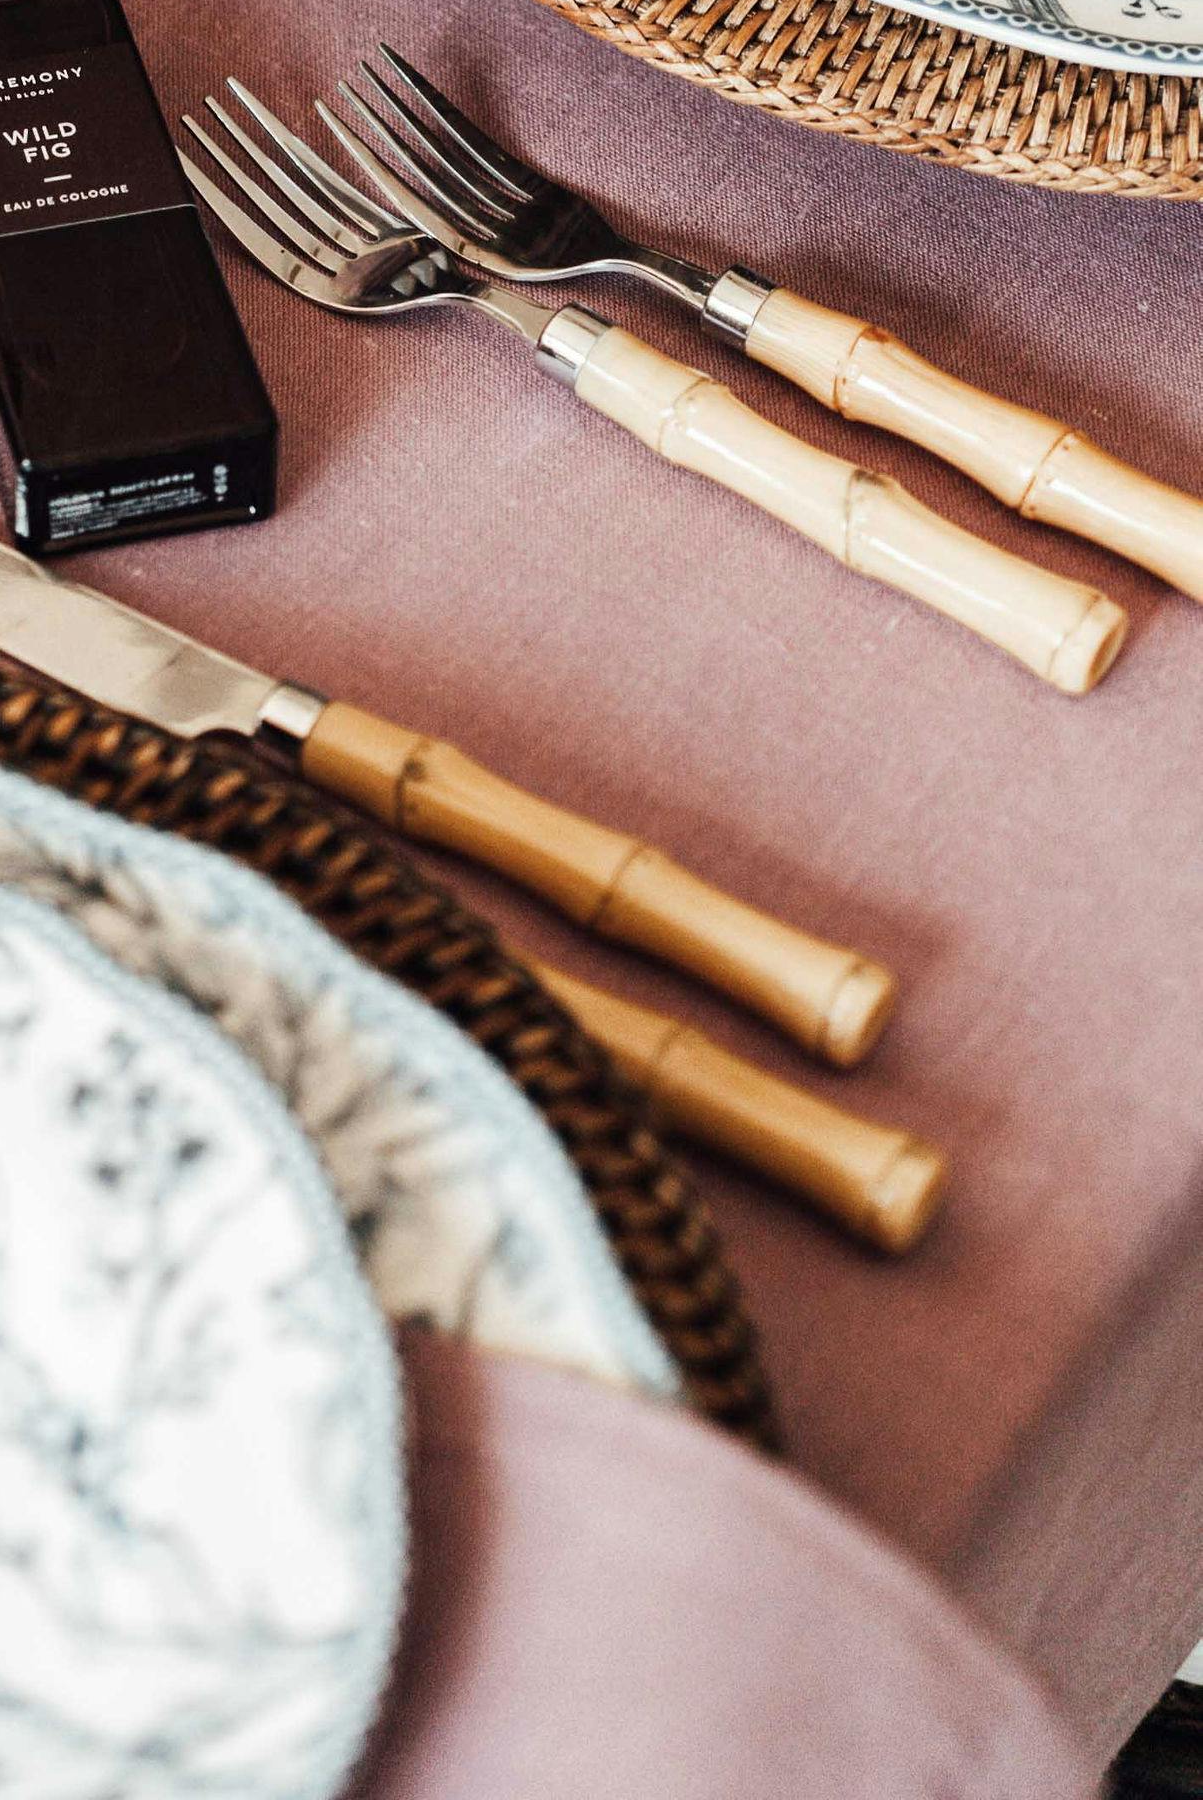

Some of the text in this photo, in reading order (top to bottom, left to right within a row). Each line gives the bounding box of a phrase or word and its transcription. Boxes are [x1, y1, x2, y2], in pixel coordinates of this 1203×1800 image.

[16, 88, 54, 100] BLOOM
[2, 121, 77, 146] WILD
[23, 142, 71, 164] FIG
[3, 184, 129, 213] EAU DE COLOGNE
